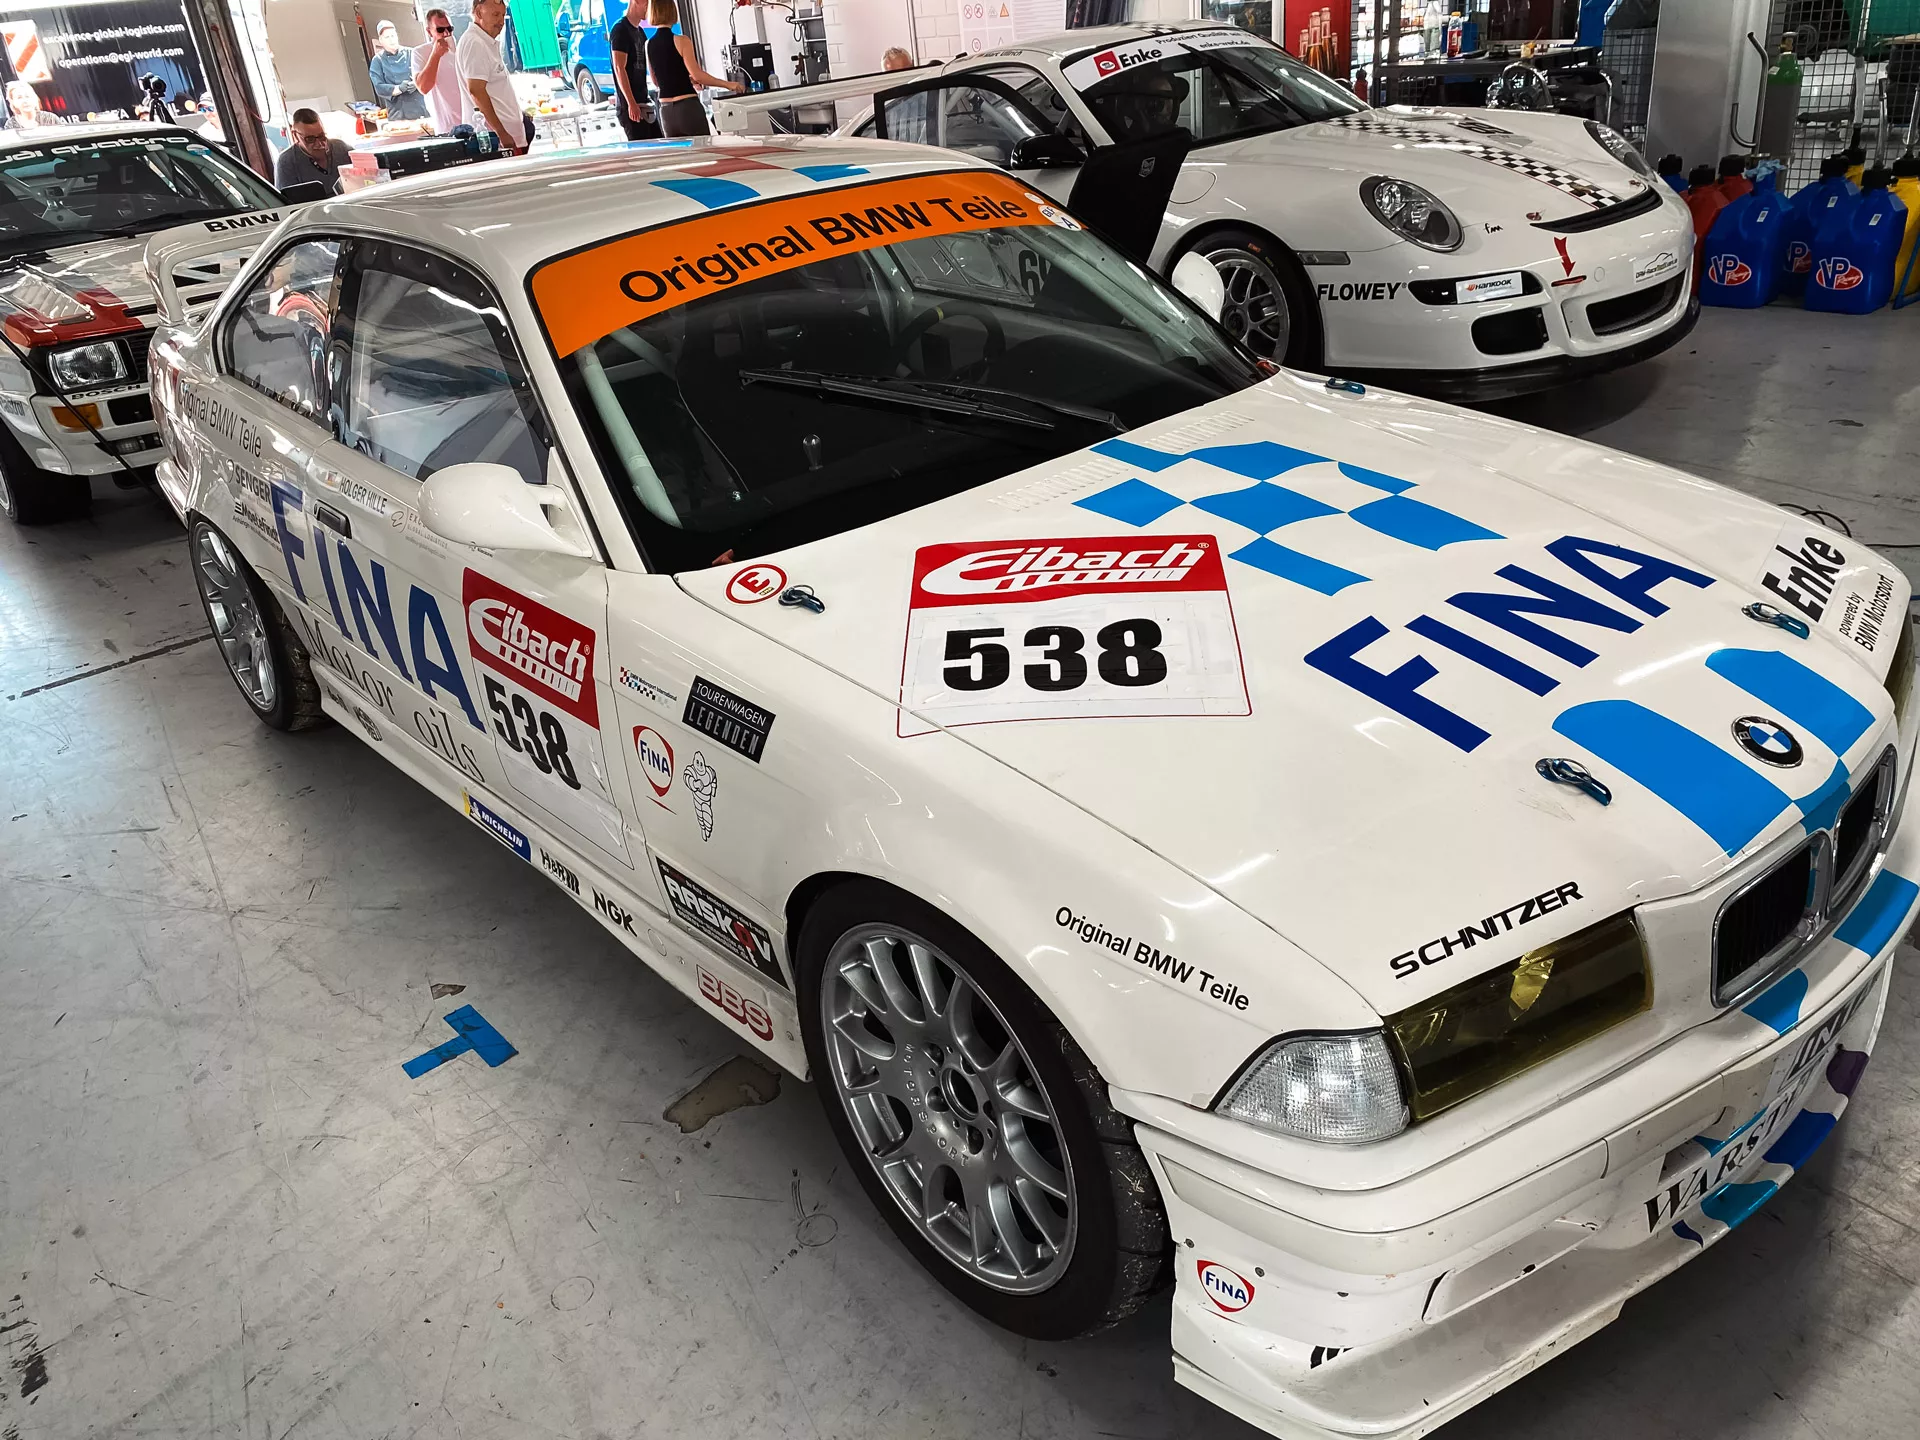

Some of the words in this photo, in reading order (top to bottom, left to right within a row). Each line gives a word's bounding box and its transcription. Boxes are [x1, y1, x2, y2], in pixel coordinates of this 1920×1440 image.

[43, 23, 185, 44] excellence-global-logistics.com
[59, 47, 184, 69] operations@egl-world.com
[1118, 49, 1162, 69] Enke
[51, 137, 189, 155] quattro
[204, 213, 280, 232] BMW
[619, 226, 815, 302] Original
[809, 201, 932, 246] BMW
[929, 195, 1028, 224] Teile
[1711, 254, 1740, 285] VP
[1819, 257, 1851, 289] VP
[71, 385, 141, 400] BOSCH
[179, 380, 208, 424] Original
[209, 400, 238, 440] BMW
[239, 417, 262, 459] Teile
[236, 465, 272, 505] SENGER
[340, 477, 368, 505] HOLGER
[367, 486, 388, 515] HILLE
[1761, 537, 1845, 623] Enke
[1846, 591, 1865, 606] by
[1863, 572, 1894, 626] Motorsport
[270, 480, 487, 734] FINA
[1839, 600, 1858, 639] powered
[1304, 535, 1717, 753] FINA
[1854, 617, 1880, 652] BMW
[943, 618, 1168, 692] 538
[304, 617, 394, 716] Motor
[413, 707, 486, 783] oils
[696, 683, 767, 726] TOURENWAGEN
[484, 673, 582, 791] 538
[688, 702, 760, 756] LEGENDEN
[640, 740, 671, 778] FINA
[482, 811, 523, 848] MICHELIN
[592, 887, 637, 937] NGK
[1389, 881, 1584, 980] SCHNITZER
[1055, 906, 1133, 956] Original
[1133, 944, 1195, 984] BMW
[1199, 970, 1250, 1011] Teile
[696, 964, 774, 1041] BBS
[1205, 1271, 1248, 1304] FINA
